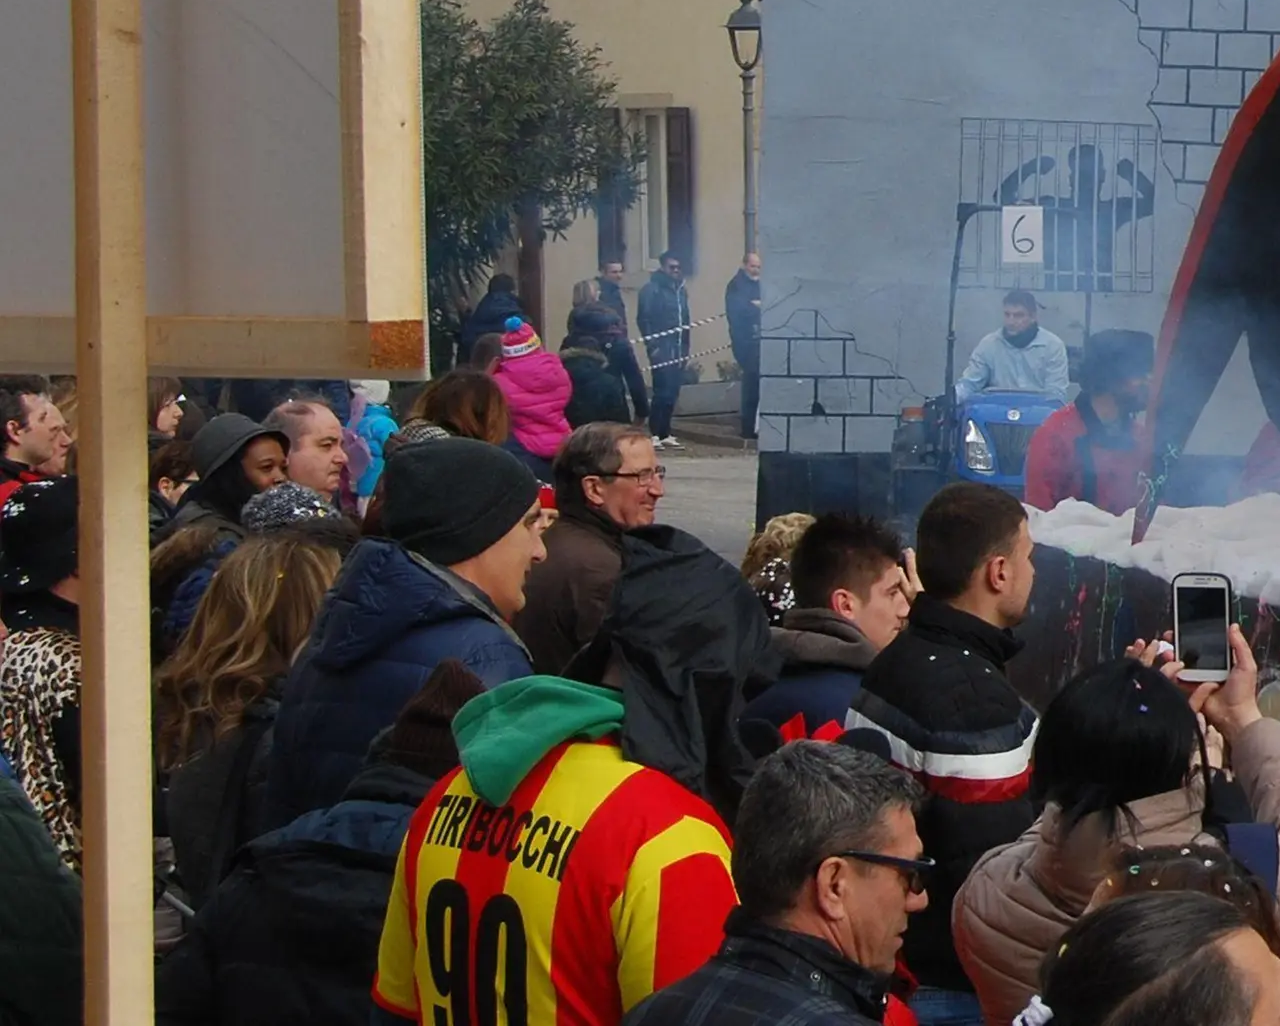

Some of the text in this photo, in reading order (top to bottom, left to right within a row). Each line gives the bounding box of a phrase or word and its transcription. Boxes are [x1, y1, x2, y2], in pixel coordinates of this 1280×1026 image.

[1010, 214, 1035, 254] 6
[425, 794, 582, 882] TIRIBOCCHI
[425, 878, 528, 1026] 90
